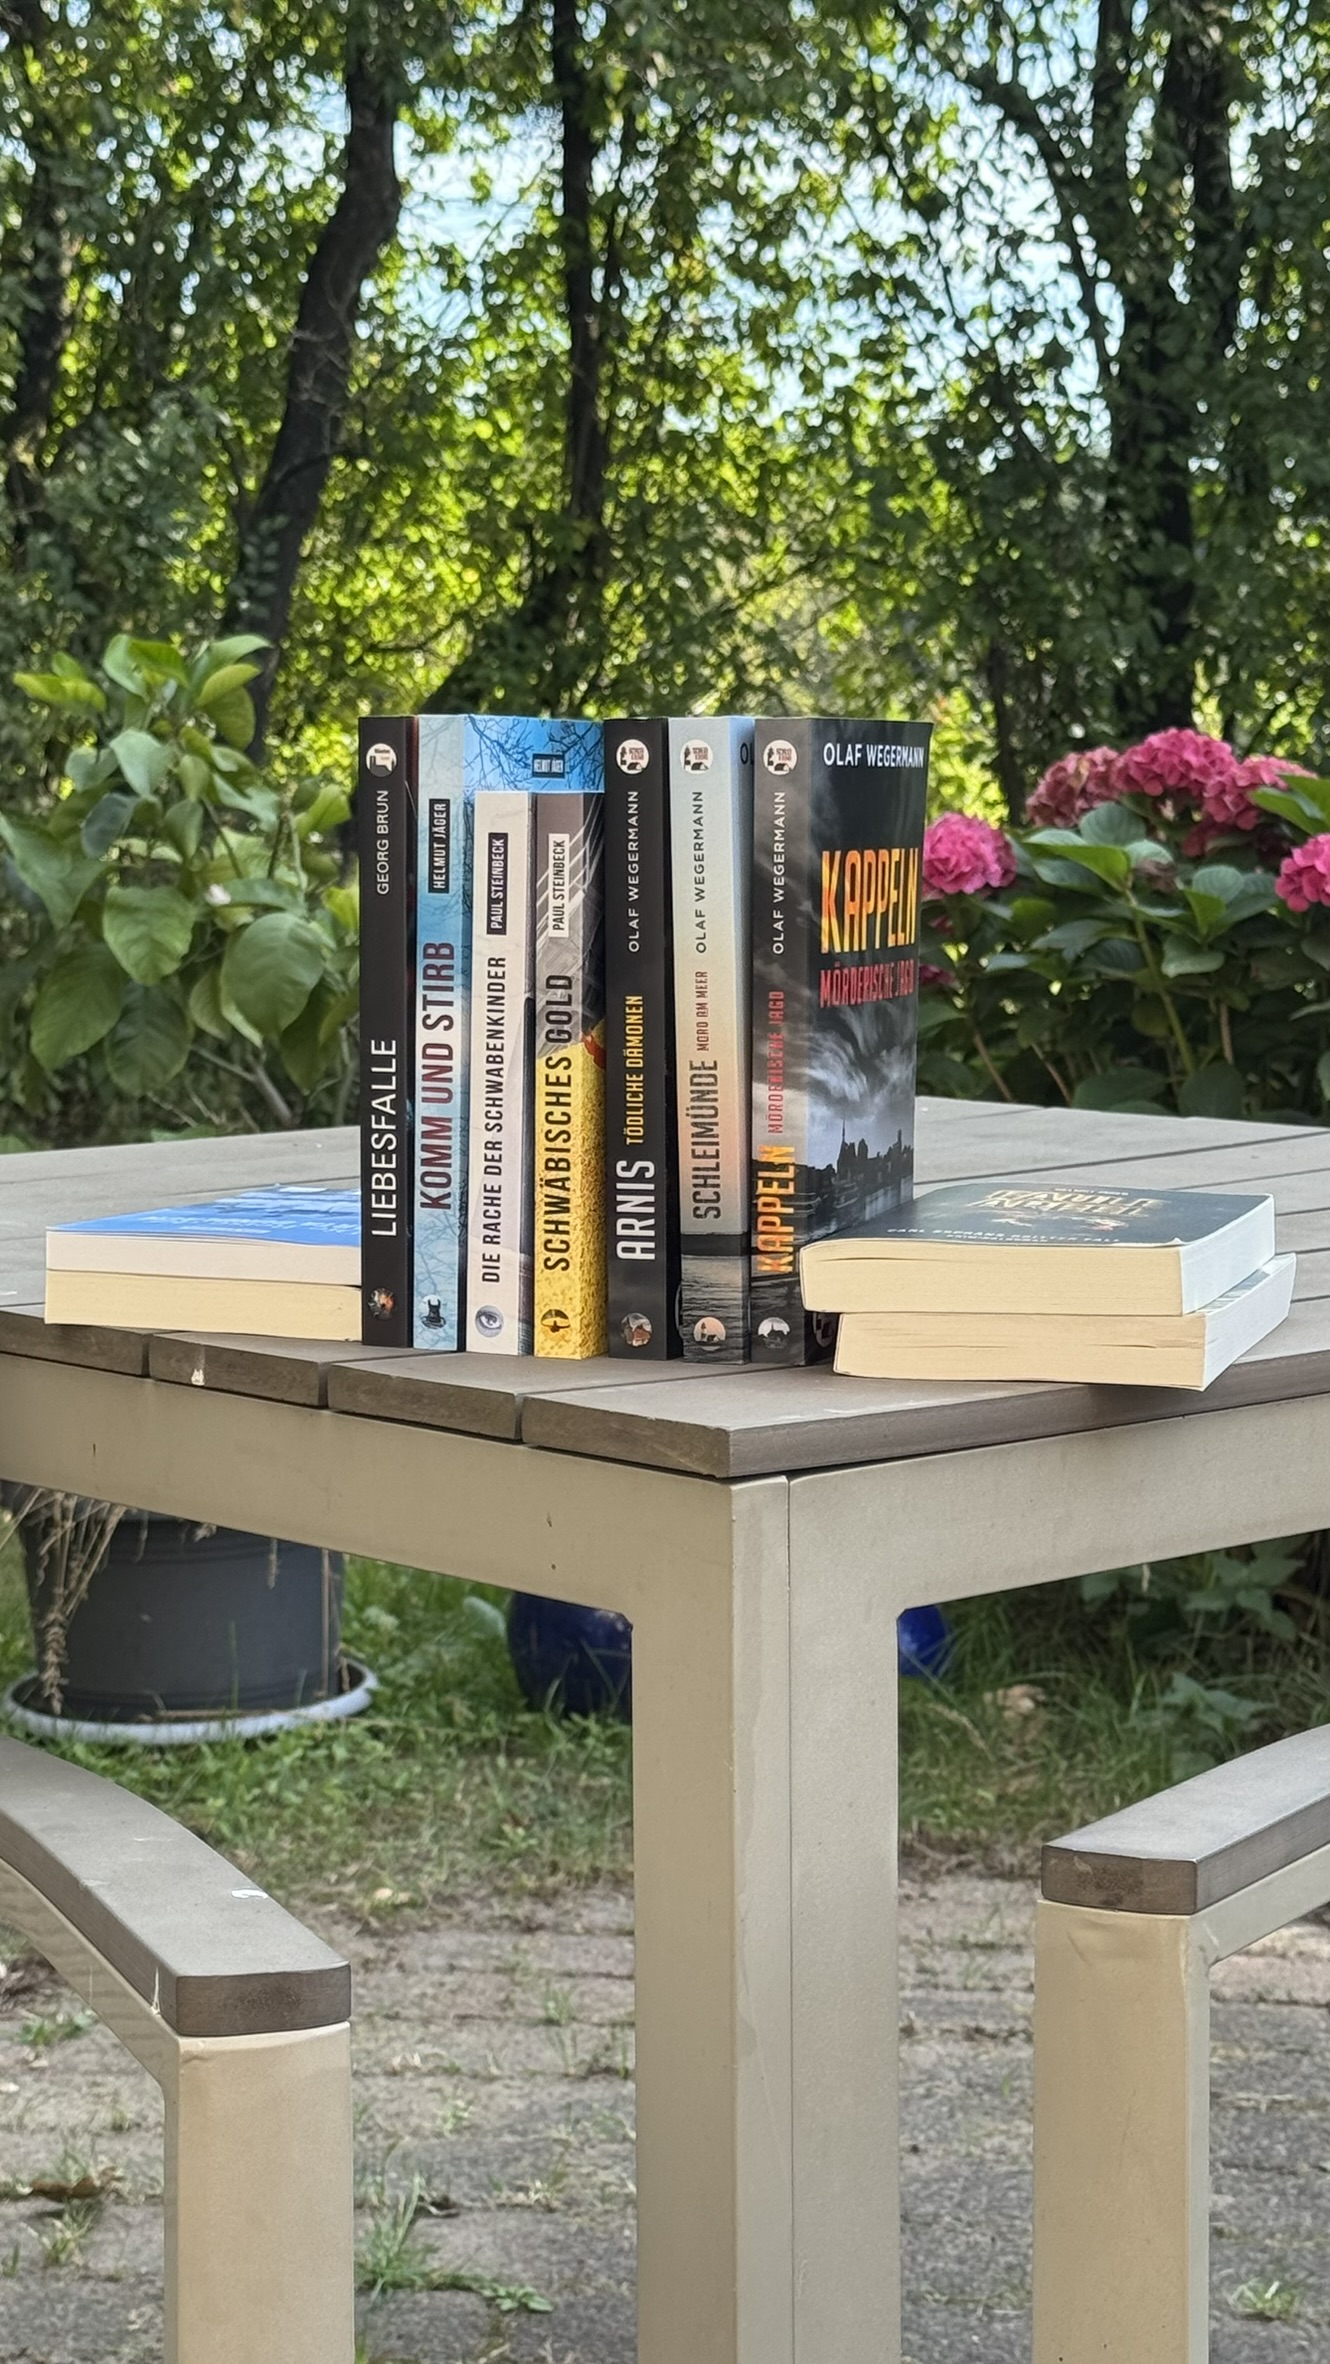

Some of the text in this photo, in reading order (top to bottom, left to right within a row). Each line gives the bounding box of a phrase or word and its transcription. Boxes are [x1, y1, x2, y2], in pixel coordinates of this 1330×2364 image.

[823, 742, 862, 767] OLAF
[866, 743, 924, 769] WEGERMANN
[376, 790, 390, 895] GEORG BRUN
[433, 802, 447, 889] HELMUT JÄGER
[490, 838, 505, 929] PAUL STEINBECK
[552, 840, 566, 931] PAUL STEINBECK
[628, 791, 640, 953] OLAF WEGERMANN
[692, 791, 707, 954] OLAF WEGERMANN
[772, 791, 786, 955] OLAF WEGERMANN
[820, 848, 919, 954] KAPPELN
[695, 971, 710, 1051] MORD AM MEER
[819, 960, 894, 1009] MÖRDERISCHE
[420, 942, 455, 1210] KOMM UND STIRB
[482, 957, 506, 1283] DIE RACHE DER SCHWABENKINDER
[539, 974, 573, 1271] SCHWÄBISCHES GOLD
[622, 995, 644, 1145] TÖDLICHE DÄMONEN
[764, 991, 785, 1134] MÖRDERISCHE JAGD
[370, 1039, 397, 1237] LIEBESFALLE
[685, 1060, 722, 1220] SCHLEIMÜNDE
[616, 1160, 656, 1261] ARNIS
[756, 1144, 796, 1273] KAPPELN
